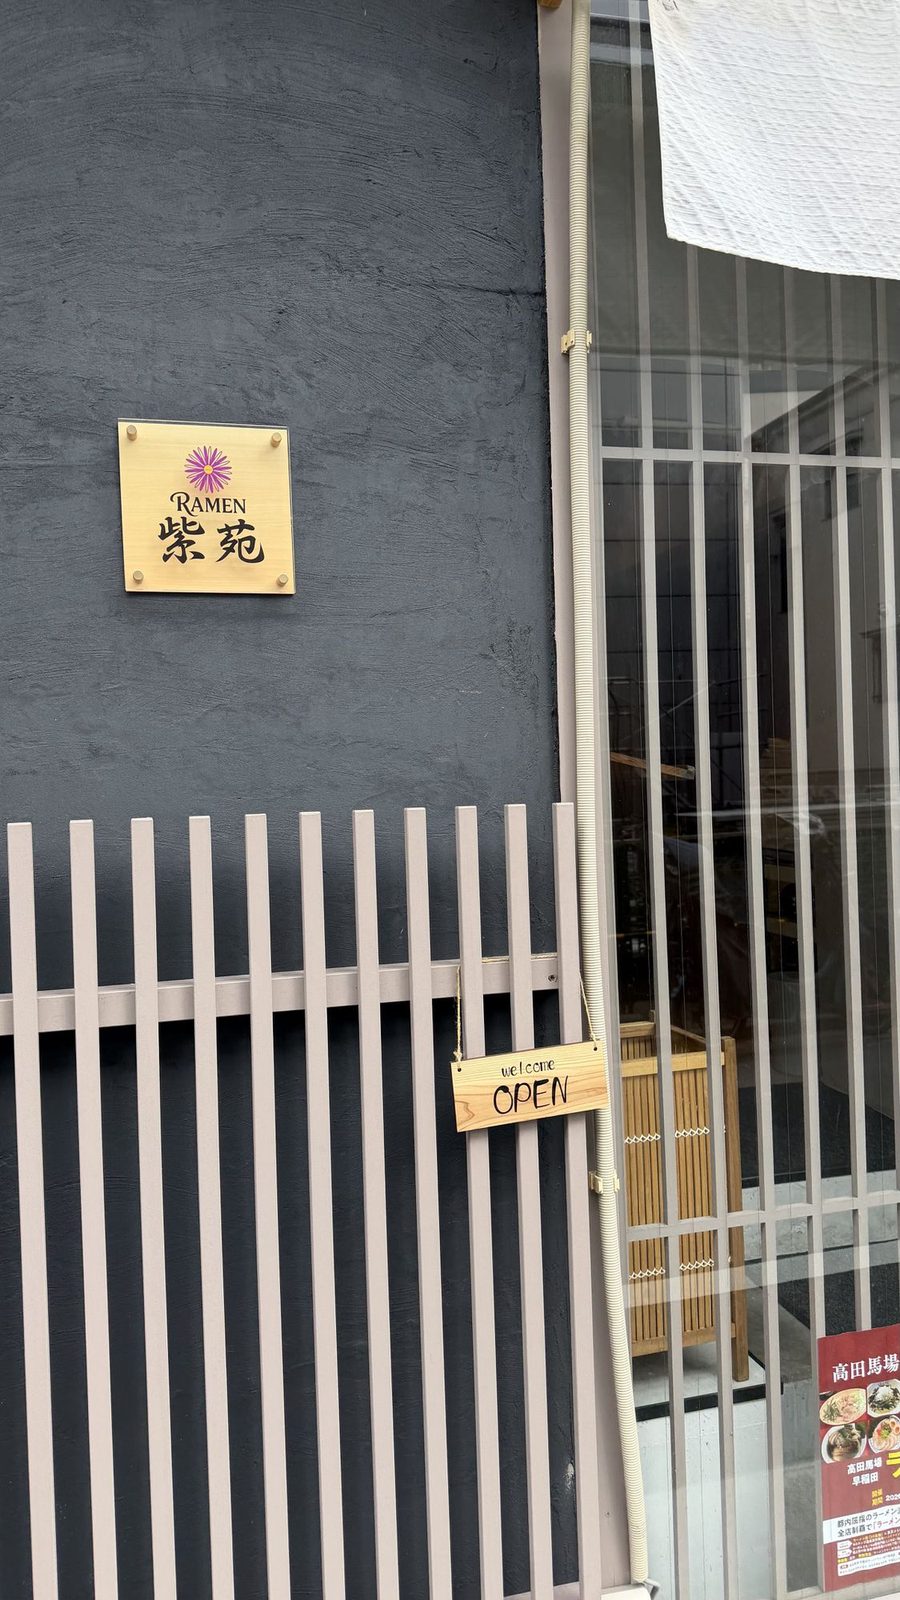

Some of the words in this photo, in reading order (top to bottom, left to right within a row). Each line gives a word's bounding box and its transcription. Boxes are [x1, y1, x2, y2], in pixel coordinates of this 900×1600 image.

[170, 491, 246, 516] RAMEN
[158, 516, 265, 564] 紫苑
[501, 1059, 556, 1078] welcome
[493, 1075, 569, 1115] OPEN
[832, 1353, 900, 1383] 高田馬場
[847, 1457, 883, 1475] 高田馬場
